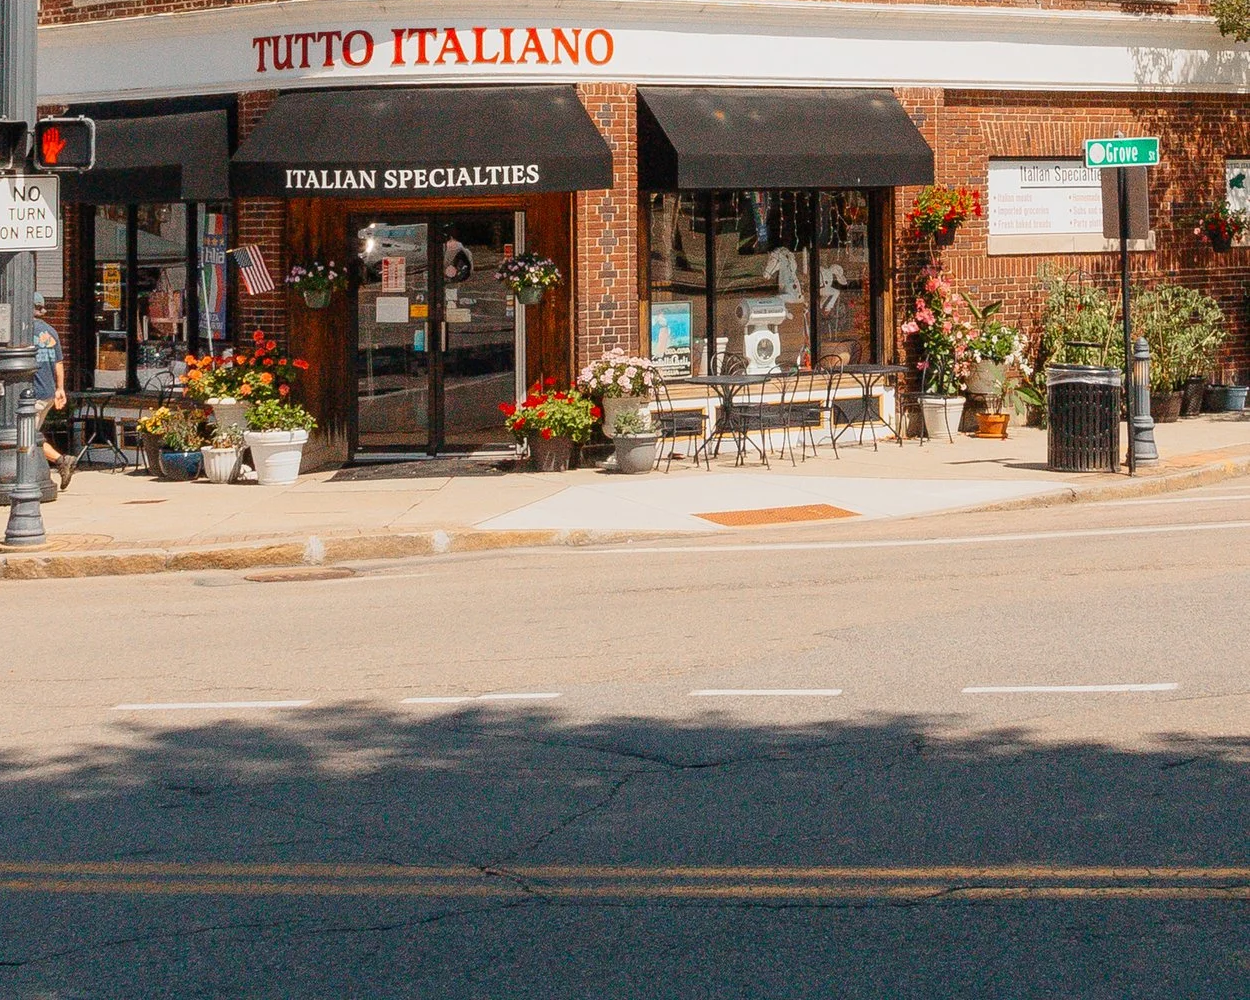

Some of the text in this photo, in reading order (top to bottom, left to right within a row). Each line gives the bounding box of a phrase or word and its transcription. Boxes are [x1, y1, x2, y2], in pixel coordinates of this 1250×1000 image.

[252, 26, 615, 73] TUTTO ITALIANO
[1105, 142, 1138, 163] Grove
[285, 164, 541, 190] ITALIAN SPECIALTIES
[1020, 165, 1102, 184] Italian Specialtie
[13, 185, 41, 202] NO
[8, 207, 46, 221] TURN
[0, 225, 54, 240] ON RED
